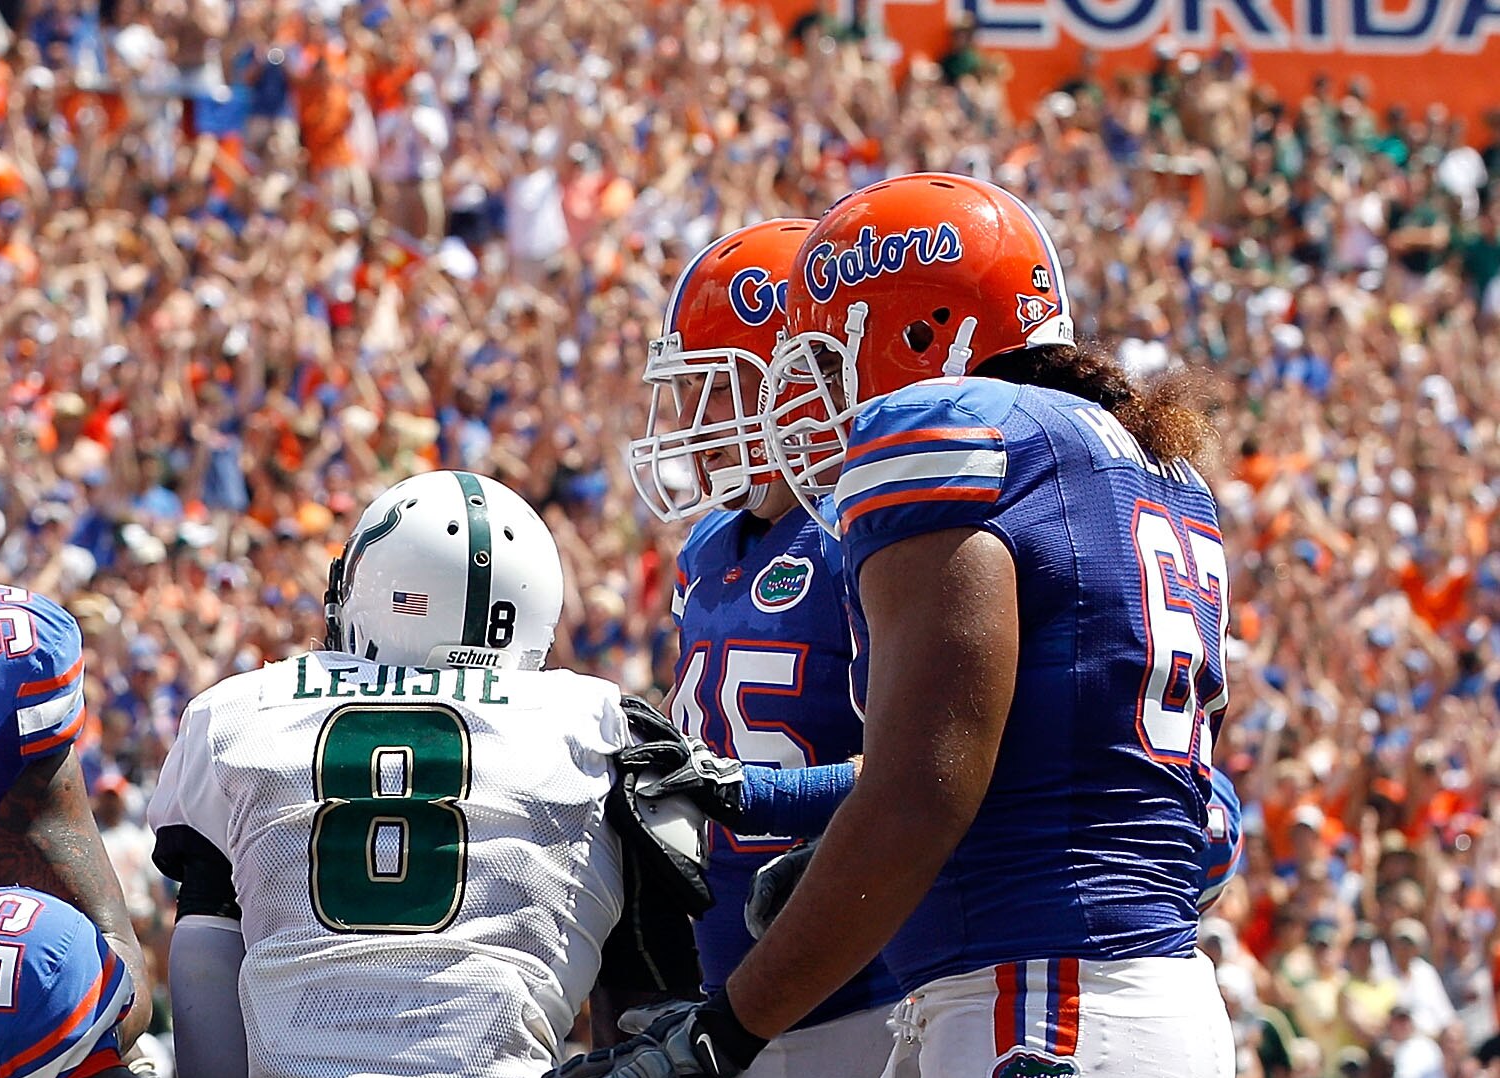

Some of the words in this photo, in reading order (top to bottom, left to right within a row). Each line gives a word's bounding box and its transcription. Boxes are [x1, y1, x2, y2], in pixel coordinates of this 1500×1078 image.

[804, 221, 963, 305] Gators
[1032, 269, 1051, 288] JH
[1026, 300, 1044, 321] SEC
[486, 599, 517, 649] 8
[1131, 498, 1232, 780] 67
[446, 649, 501, 667] schutt
[307, 701, 472, 936] 8
